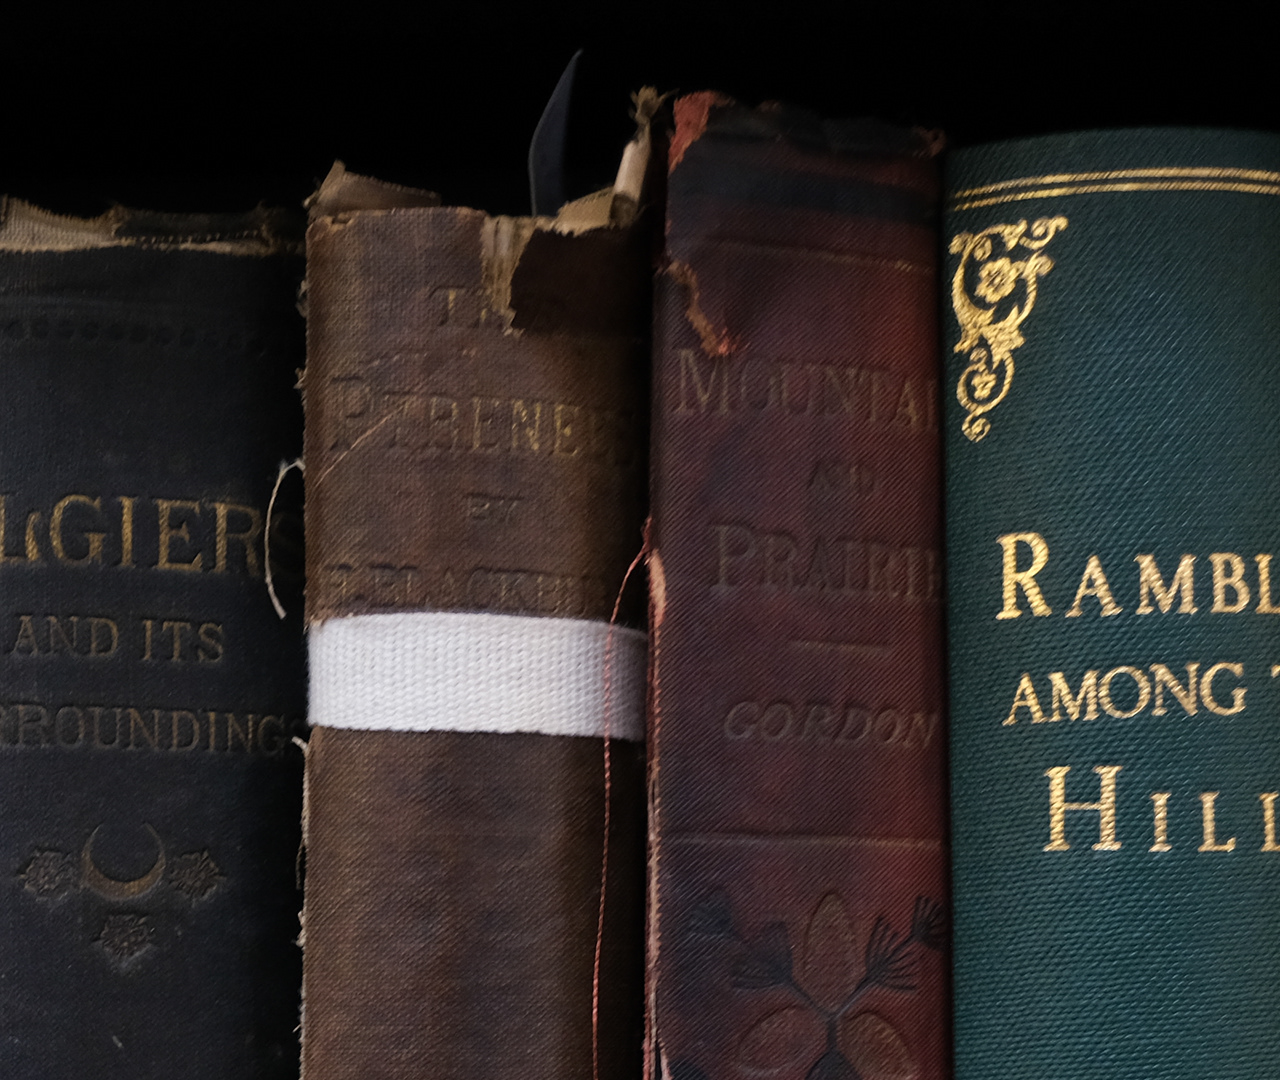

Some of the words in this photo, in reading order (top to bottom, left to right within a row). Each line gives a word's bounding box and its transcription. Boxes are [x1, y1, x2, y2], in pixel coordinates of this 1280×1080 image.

[6, 614, 120, 663] AND
[139, 618, 224, 665] ITS
[1001, 661, 1248, 726] AMONG
[724, 699, 938, 750] GORDON
